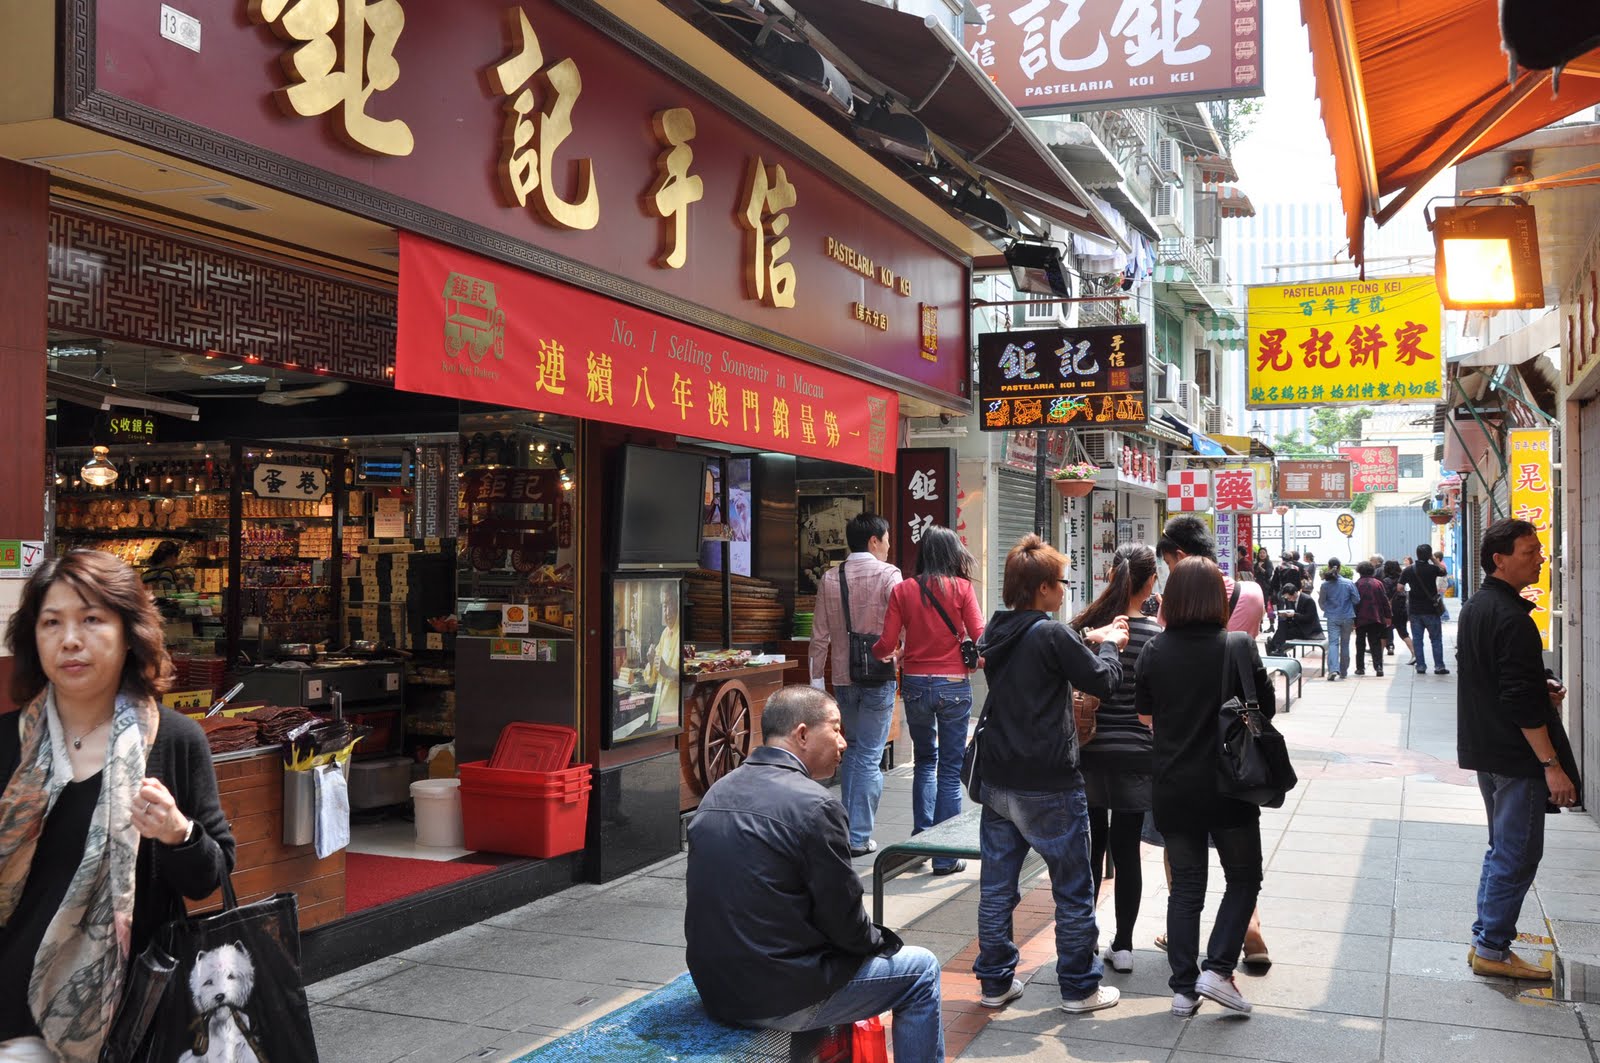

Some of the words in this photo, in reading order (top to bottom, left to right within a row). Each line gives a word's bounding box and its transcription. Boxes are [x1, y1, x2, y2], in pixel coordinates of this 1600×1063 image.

[163, 12, 177, 34] 13
[1025, 79, 1114, 96] PASTELARIA
[1129, 76, 1154, 87] KOI
[1170, 71, 1194, 83] KEI
[826, 236, 875, 279] PASTELARIA
[880, 265, 894, 288] KOI
[899, 276, 912, 297] KEI
[451, 275, 488, 305] 鉅記
[1283, 284, 1345, 299] PASTELARIA
[1350, 283, 1379, 295] FONG
[1384, 281, 1401, 293] KEI
[611, 318, 636, 349] No.
[650, 330, 657, 353] 1
[668, 335, 712, 374] Selling
[720, 350, 769, 384] Souvenir
[776, 368, 786, 389] in
[793, 373, 824, 400] Macau
[998, 339, 1100, 380] 鉅記
[1109, 334, 1126, 368] 手信
[1256, 320, 1436, 373] 晃記餅家
[535, 338, 861, 449] 連續八年澳門銷量第一
[1001, 382, 1055, 392] PASTELARIA
[1060, 381, 1075, 389] KOI
[1081, 380, 1095, 388] KEI
[120, 417, 154, 435] 收銀台
[477, 472, 543, 500] 鉅記
[1215, 470, 1254, 510] 藥
